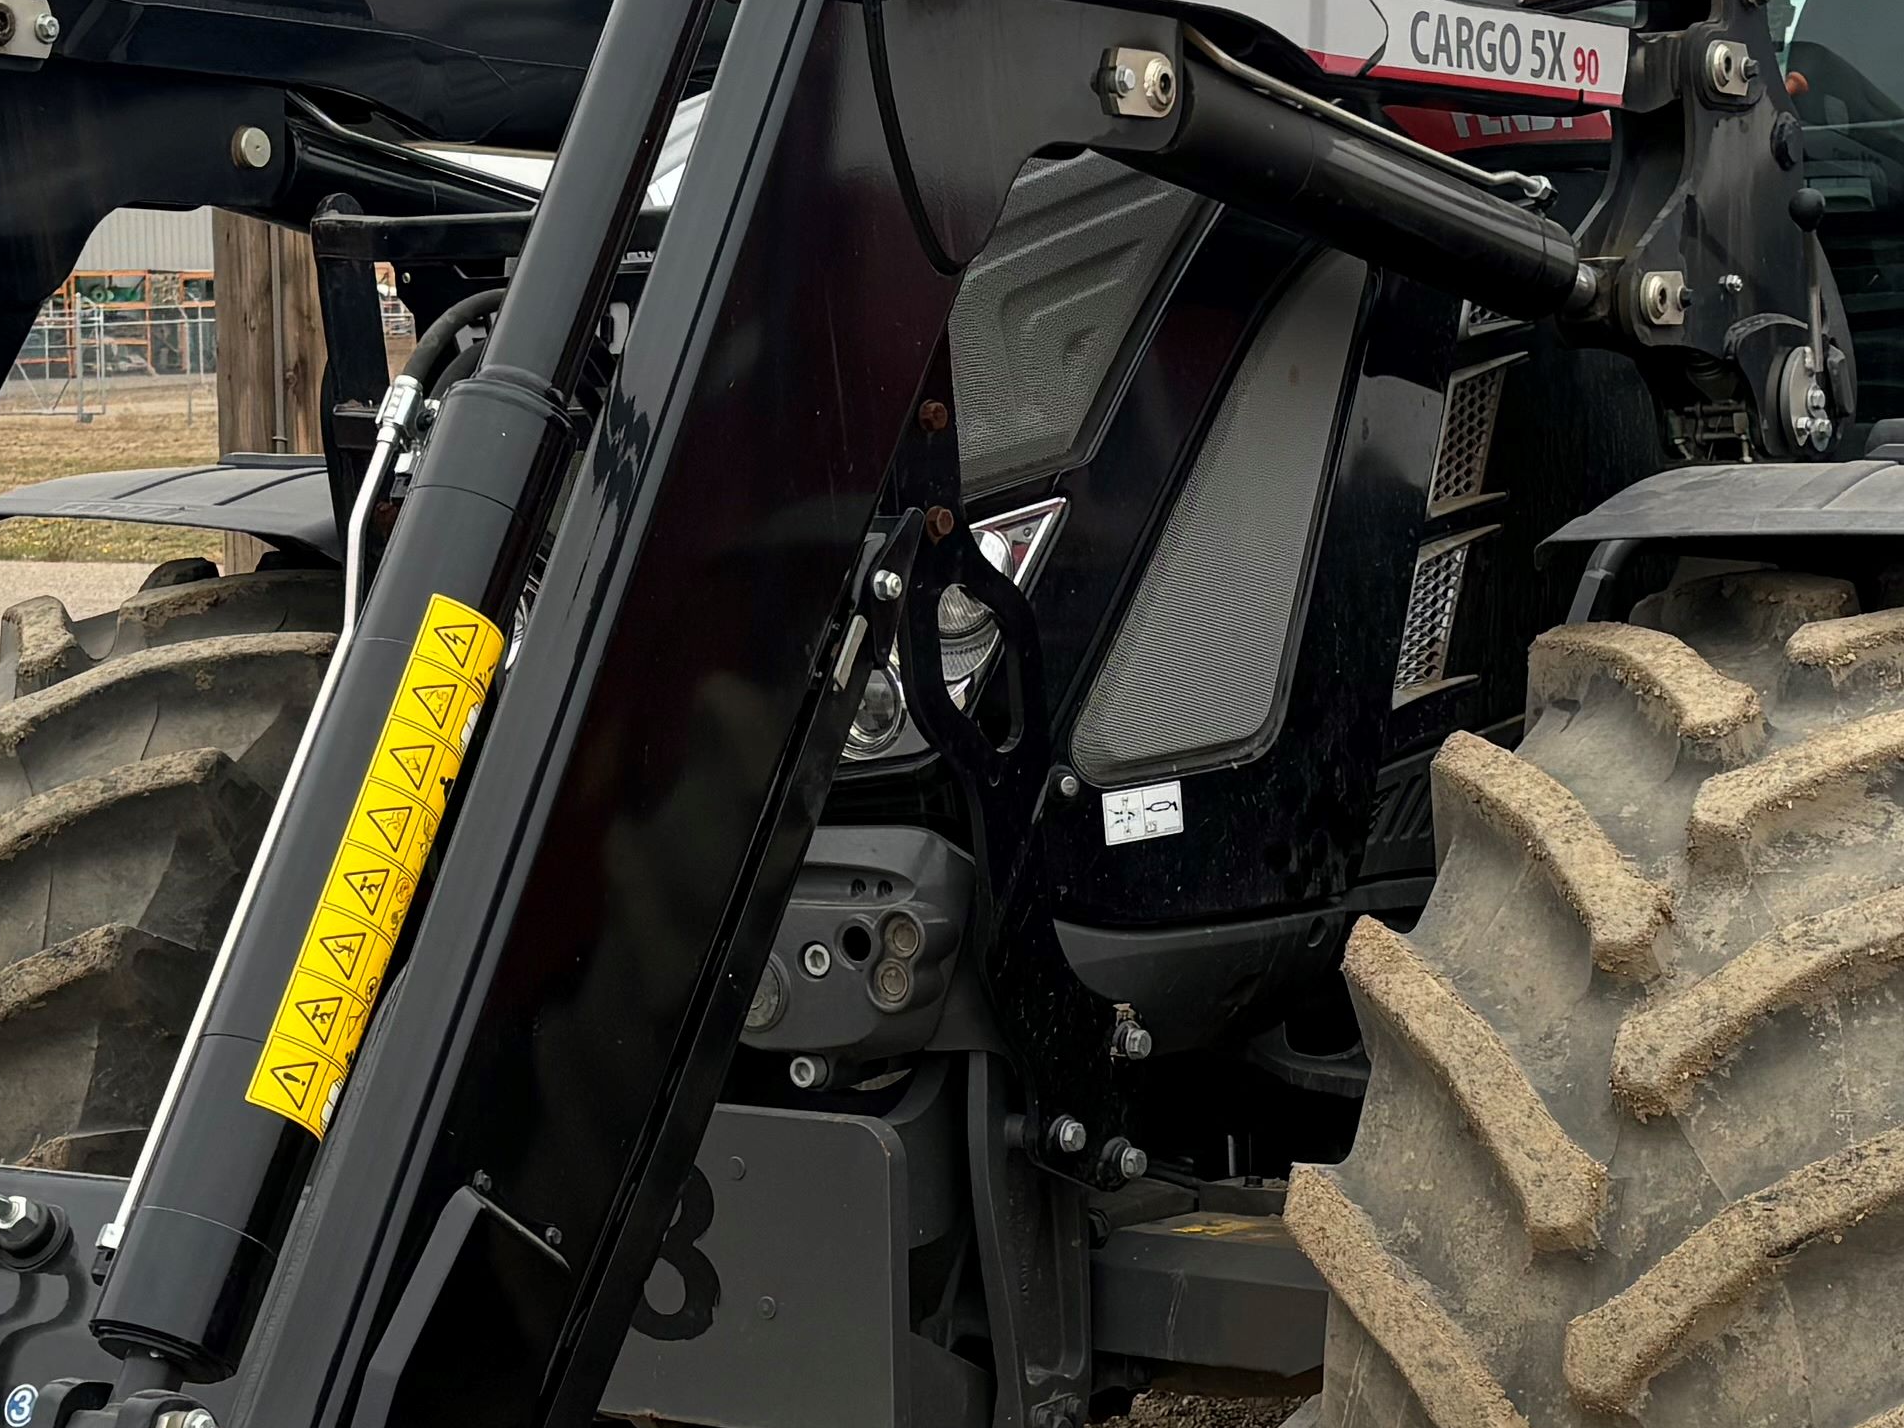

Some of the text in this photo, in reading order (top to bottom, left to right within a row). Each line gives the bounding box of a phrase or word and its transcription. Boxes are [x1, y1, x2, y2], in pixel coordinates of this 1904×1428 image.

[1409, 10, 1600, 86] CARGO 5X 90
[10, 1389, 33, 1422] 3
